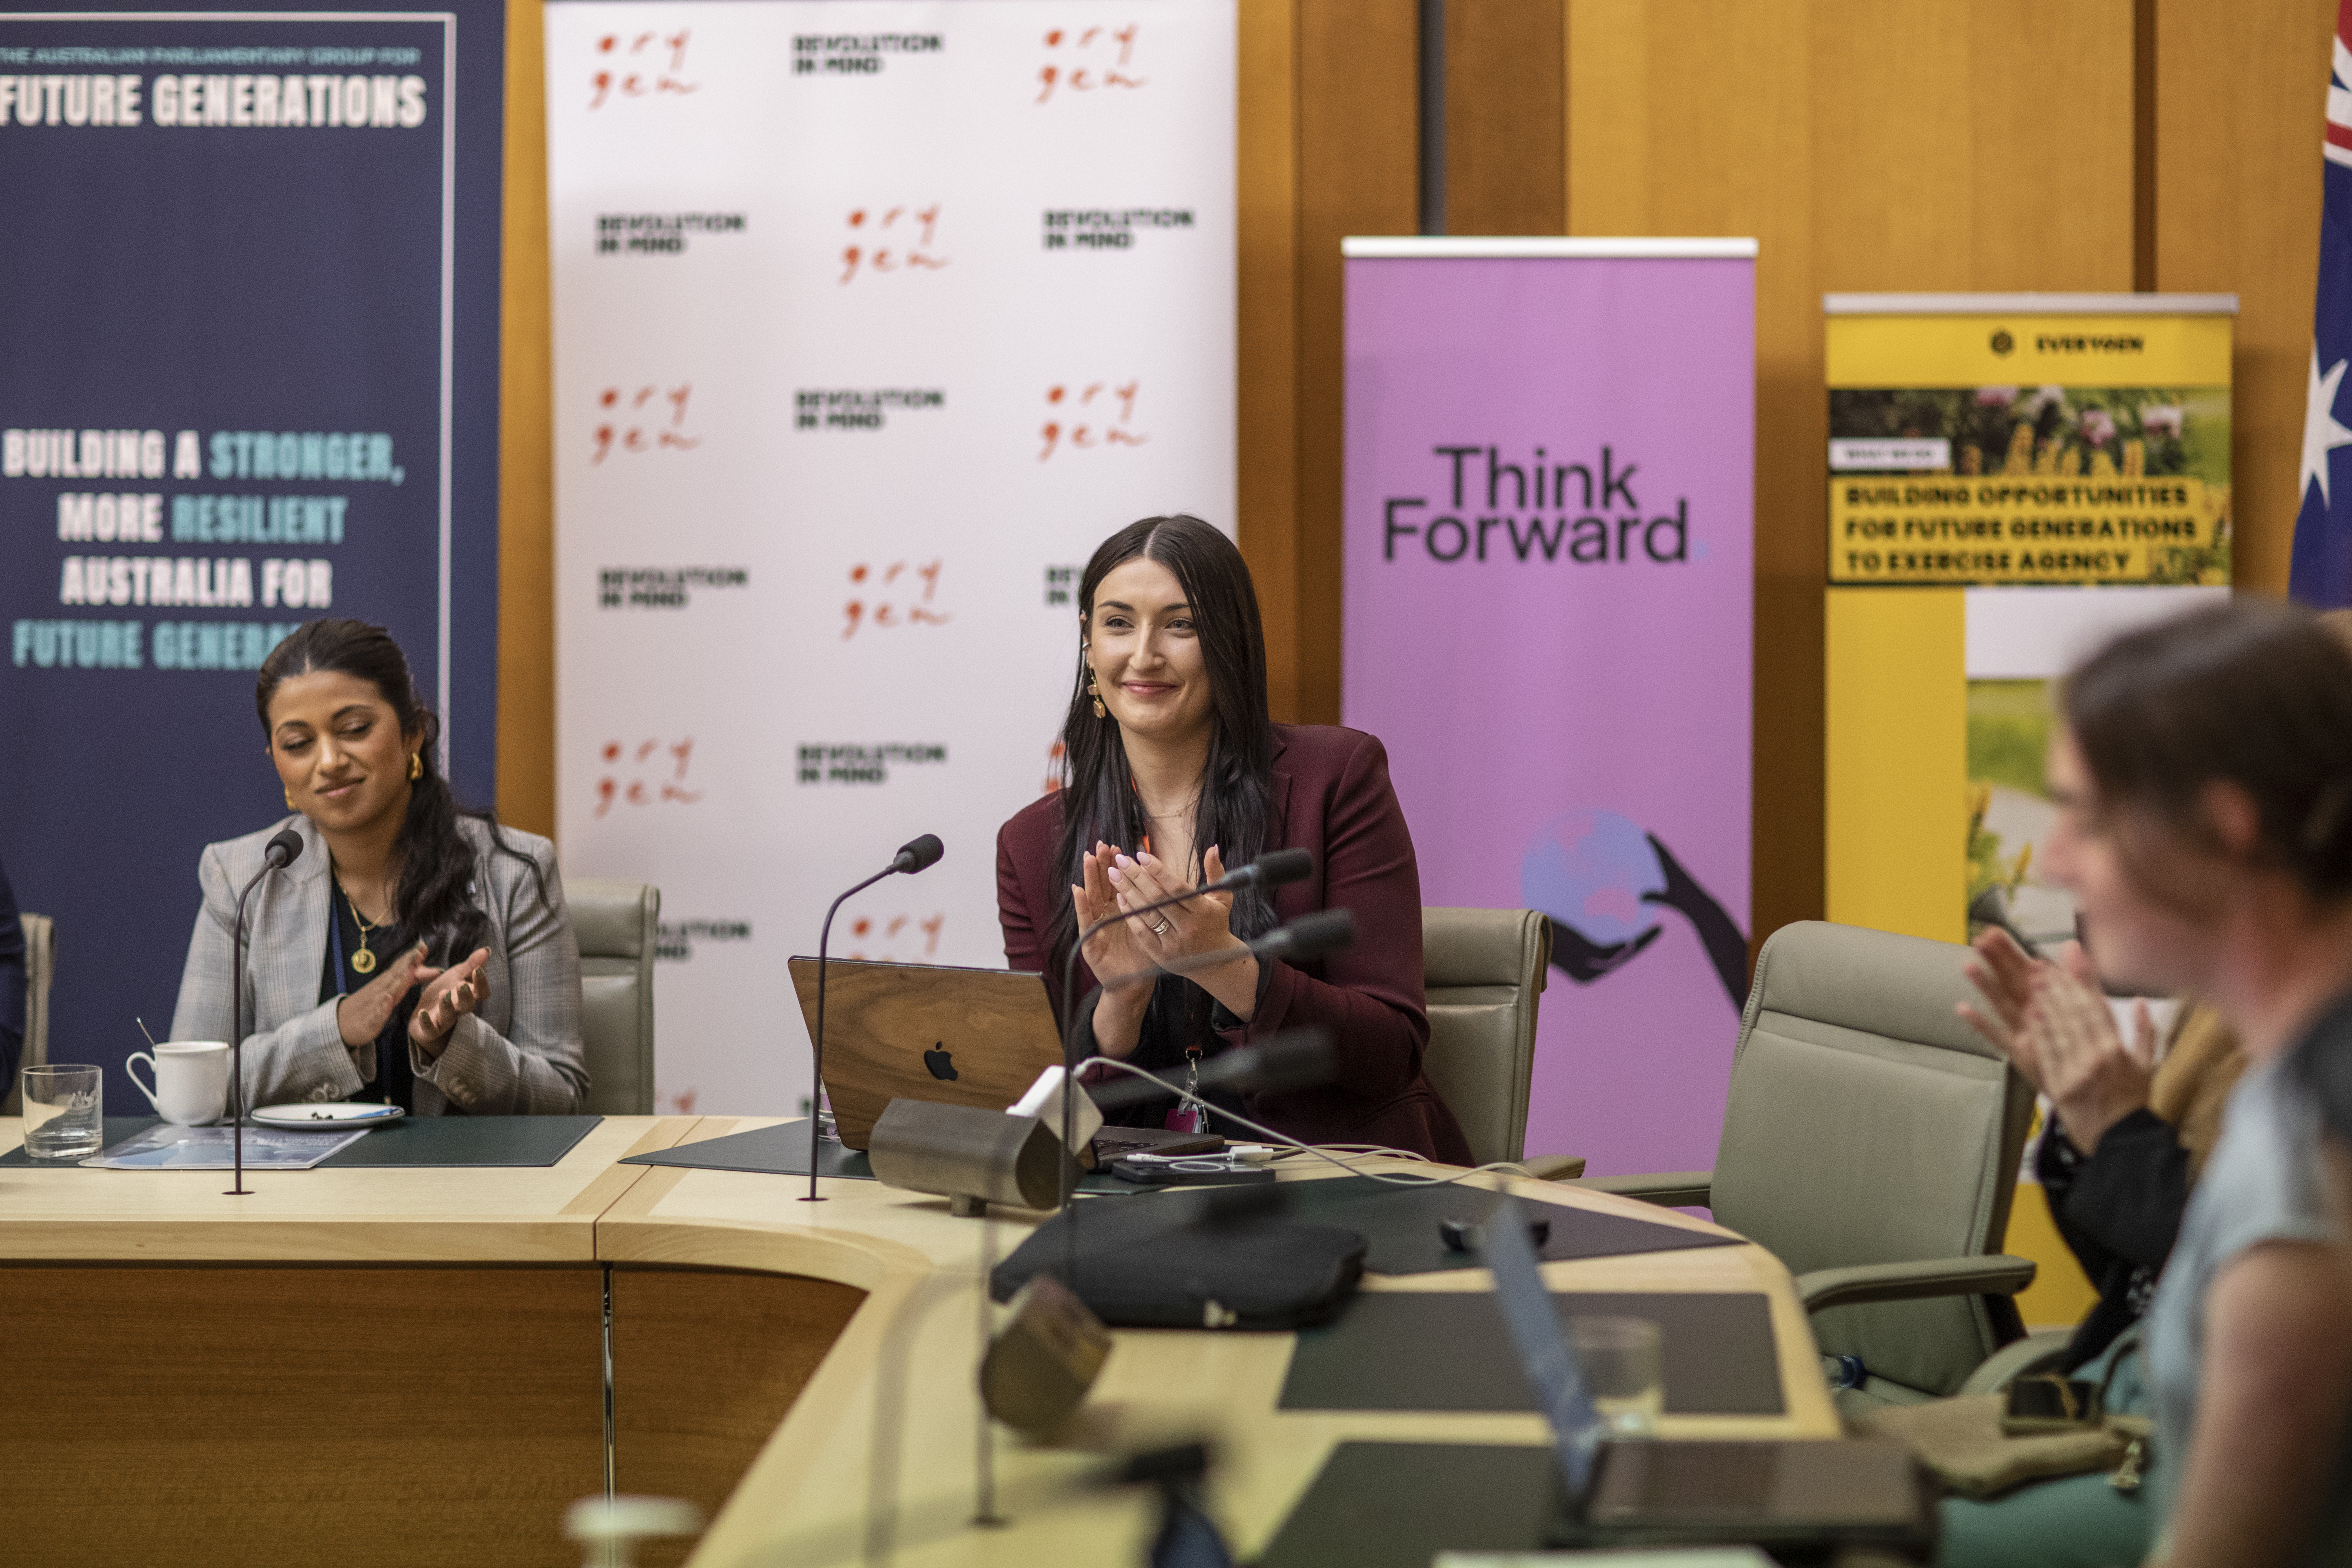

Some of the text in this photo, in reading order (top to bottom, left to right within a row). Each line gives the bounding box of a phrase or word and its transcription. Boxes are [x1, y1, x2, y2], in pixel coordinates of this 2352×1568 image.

[792, 33, 943, 53] REVOLUTION
[793, 54, 882, 75] IN MIND
[0, 75, 426, 127] FUTURE GENERATIONS
[595, 214, 746, 233] REVOLUTION
[1044, 209, 1195, 228] REVOLUTION
[597, 234, 685, 255] IN MIND
[1044, 230, 1134, 250] IN MIND
[794, 390, 944, 408] REVOLUTION
[795, 410, 884, 430] IN MIND
[3, 429, 404, 485] BUILDING A STRONGER,
[1433, 445, 1638, 510] Think
[1845, 484, 2188, 507] BUILDING OPPORTUNITIES
[58, 493, 348, 543] MORE RESILIENT
[1383, 497, 1688, 564] Forward
[1845, 517, 2197, 541] FOR FUTURE GENERATIONS
[1846, 550, 2130, 573] TO EXERCISE AGENCY
[60, 556, 332, 608] AUSTRALIA FOR
[598, 568, 748, 587] REVOLUTION
[599, 588, 688, 608] IN MIND
[13, 620, 303, 670] FUTURE GENERA
[796, 744, 947, 762] REVOLUTION
[797, 764, 886, 784] IN MIND
